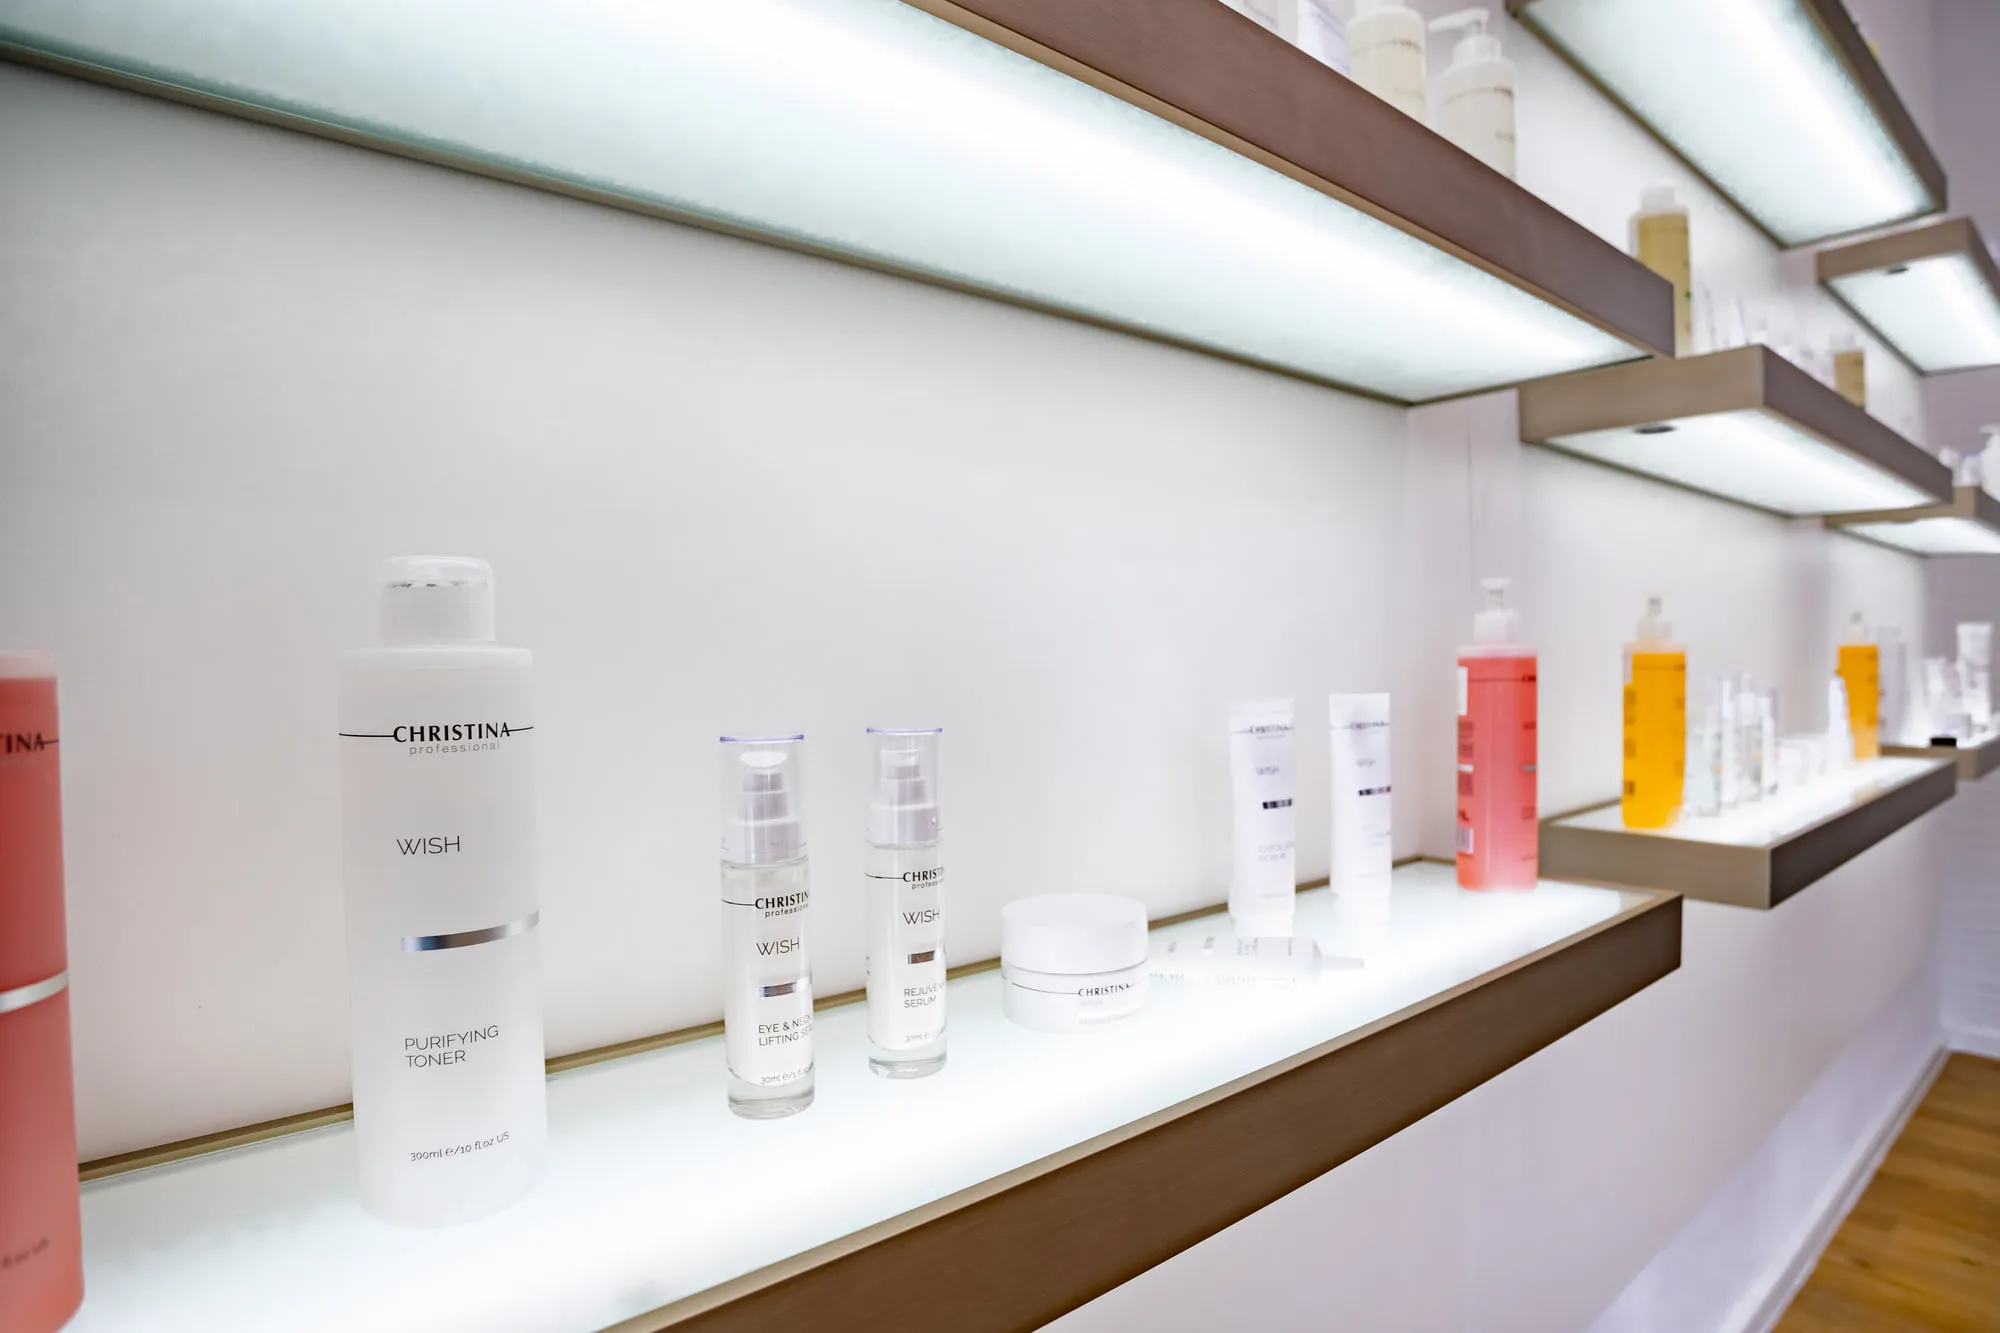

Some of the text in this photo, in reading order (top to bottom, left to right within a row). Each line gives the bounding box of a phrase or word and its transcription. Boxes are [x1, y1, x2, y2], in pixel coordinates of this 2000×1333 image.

[394, 722, 510, 742] CHRISTINA
[409, 741, 500, 756] professional
[397, 835, 460, 855] WISH
[903, 908, 940, 924] WISH
[756, 937, 800, 955] WISH
[904, 996, 937, 1008] SERUM
[758, 1023, 779, 1034] EYE
[783, 1021, 790, 1031] &
[405, 1025, 499, 1050] PURIFYING
[759, 1031, 799, 1046] LIFTING
[405, 1050, 466, 1068] TONER
[410, 1148, 442, 1162] 300ml
[496, 1131, 510, 1144] US
